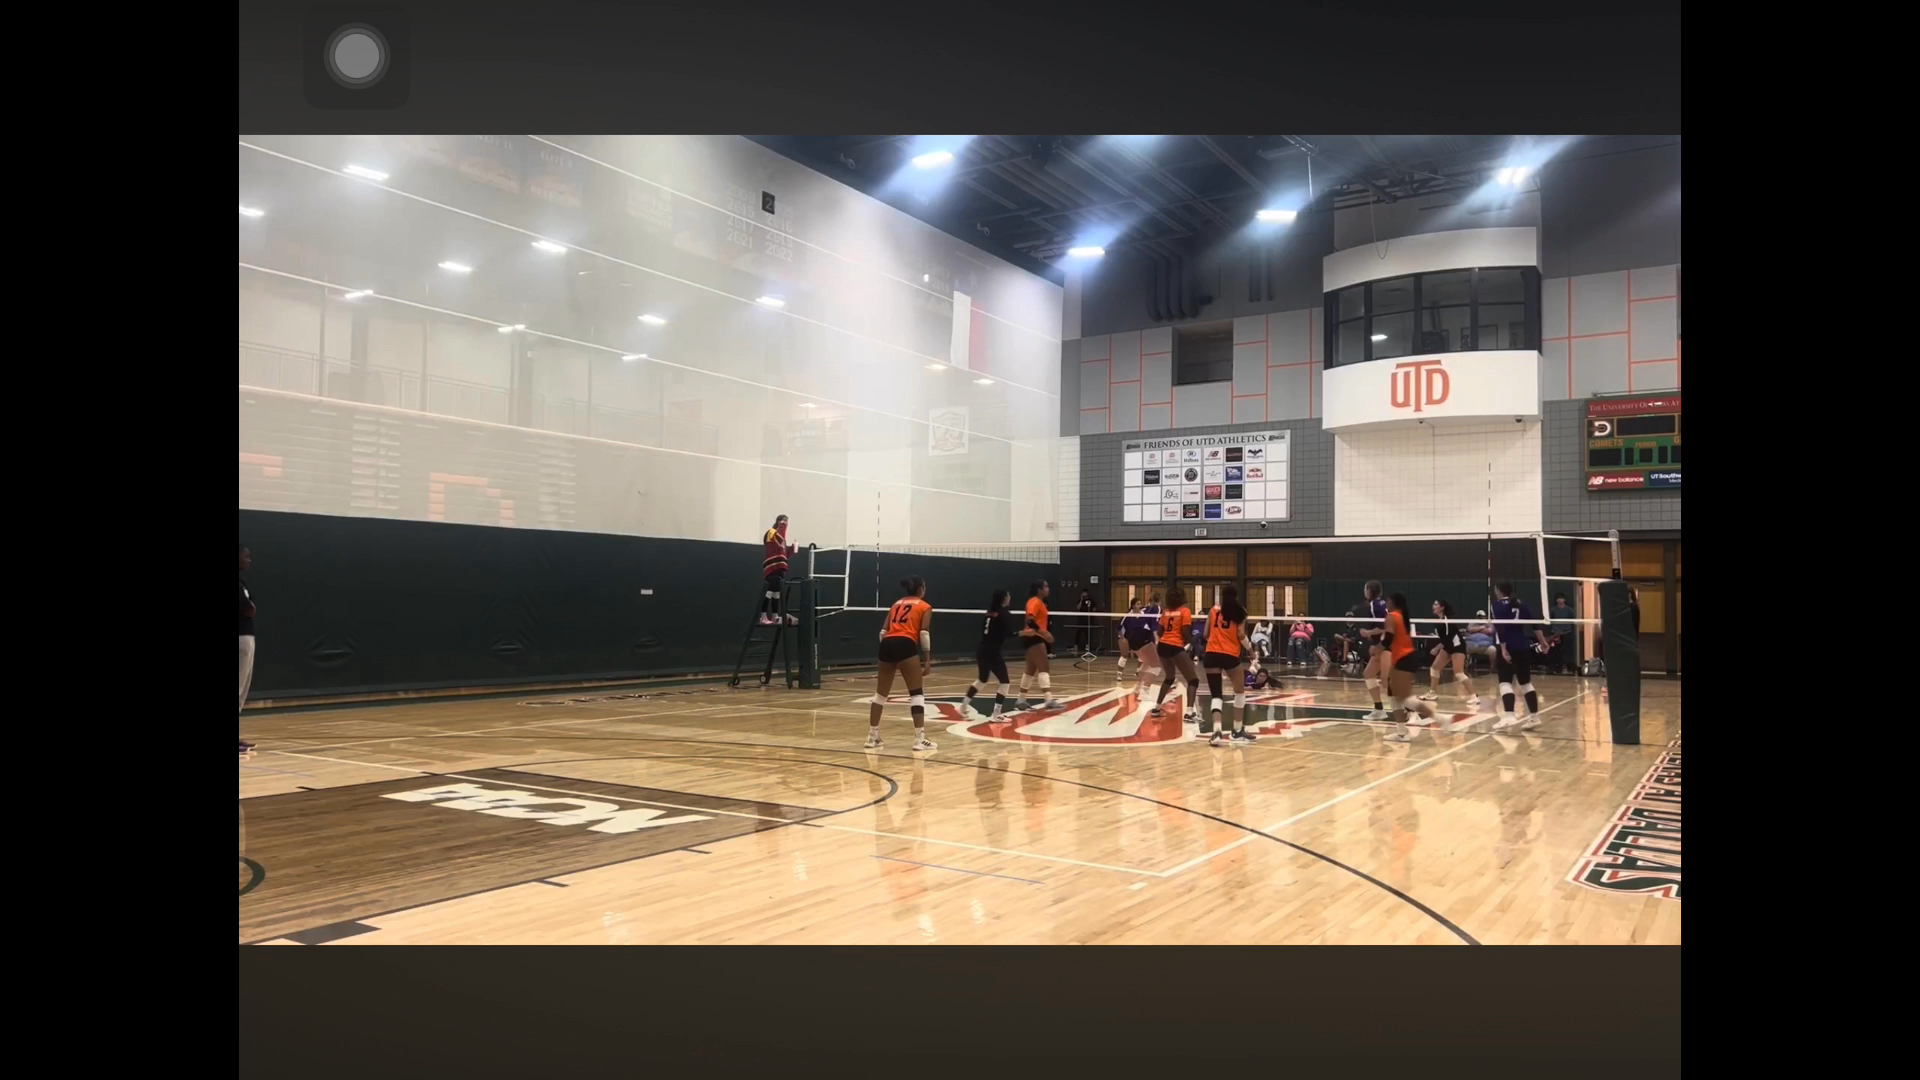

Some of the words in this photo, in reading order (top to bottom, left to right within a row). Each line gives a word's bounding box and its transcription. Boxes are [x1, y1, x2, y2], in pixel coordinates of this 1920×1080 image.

[727, 228, 753, 249] 2021
[765, 241, 793, 262] 2022
[1390, 359, 1450, 412] UTD
[1144, 439, 1181, 449] FRIENDS
[1182, 438, 1195, 447] OF
[1196, 437, 1215, 446] UTD
[1217, 434, 1267, 445] ATHLETICS
[1589, 439, 1624, 448] COMETS
[892, 604, 912, 623] 12
[1511, 607, 1520, 621] 7
[1167, 617, 1174, 632] 6
